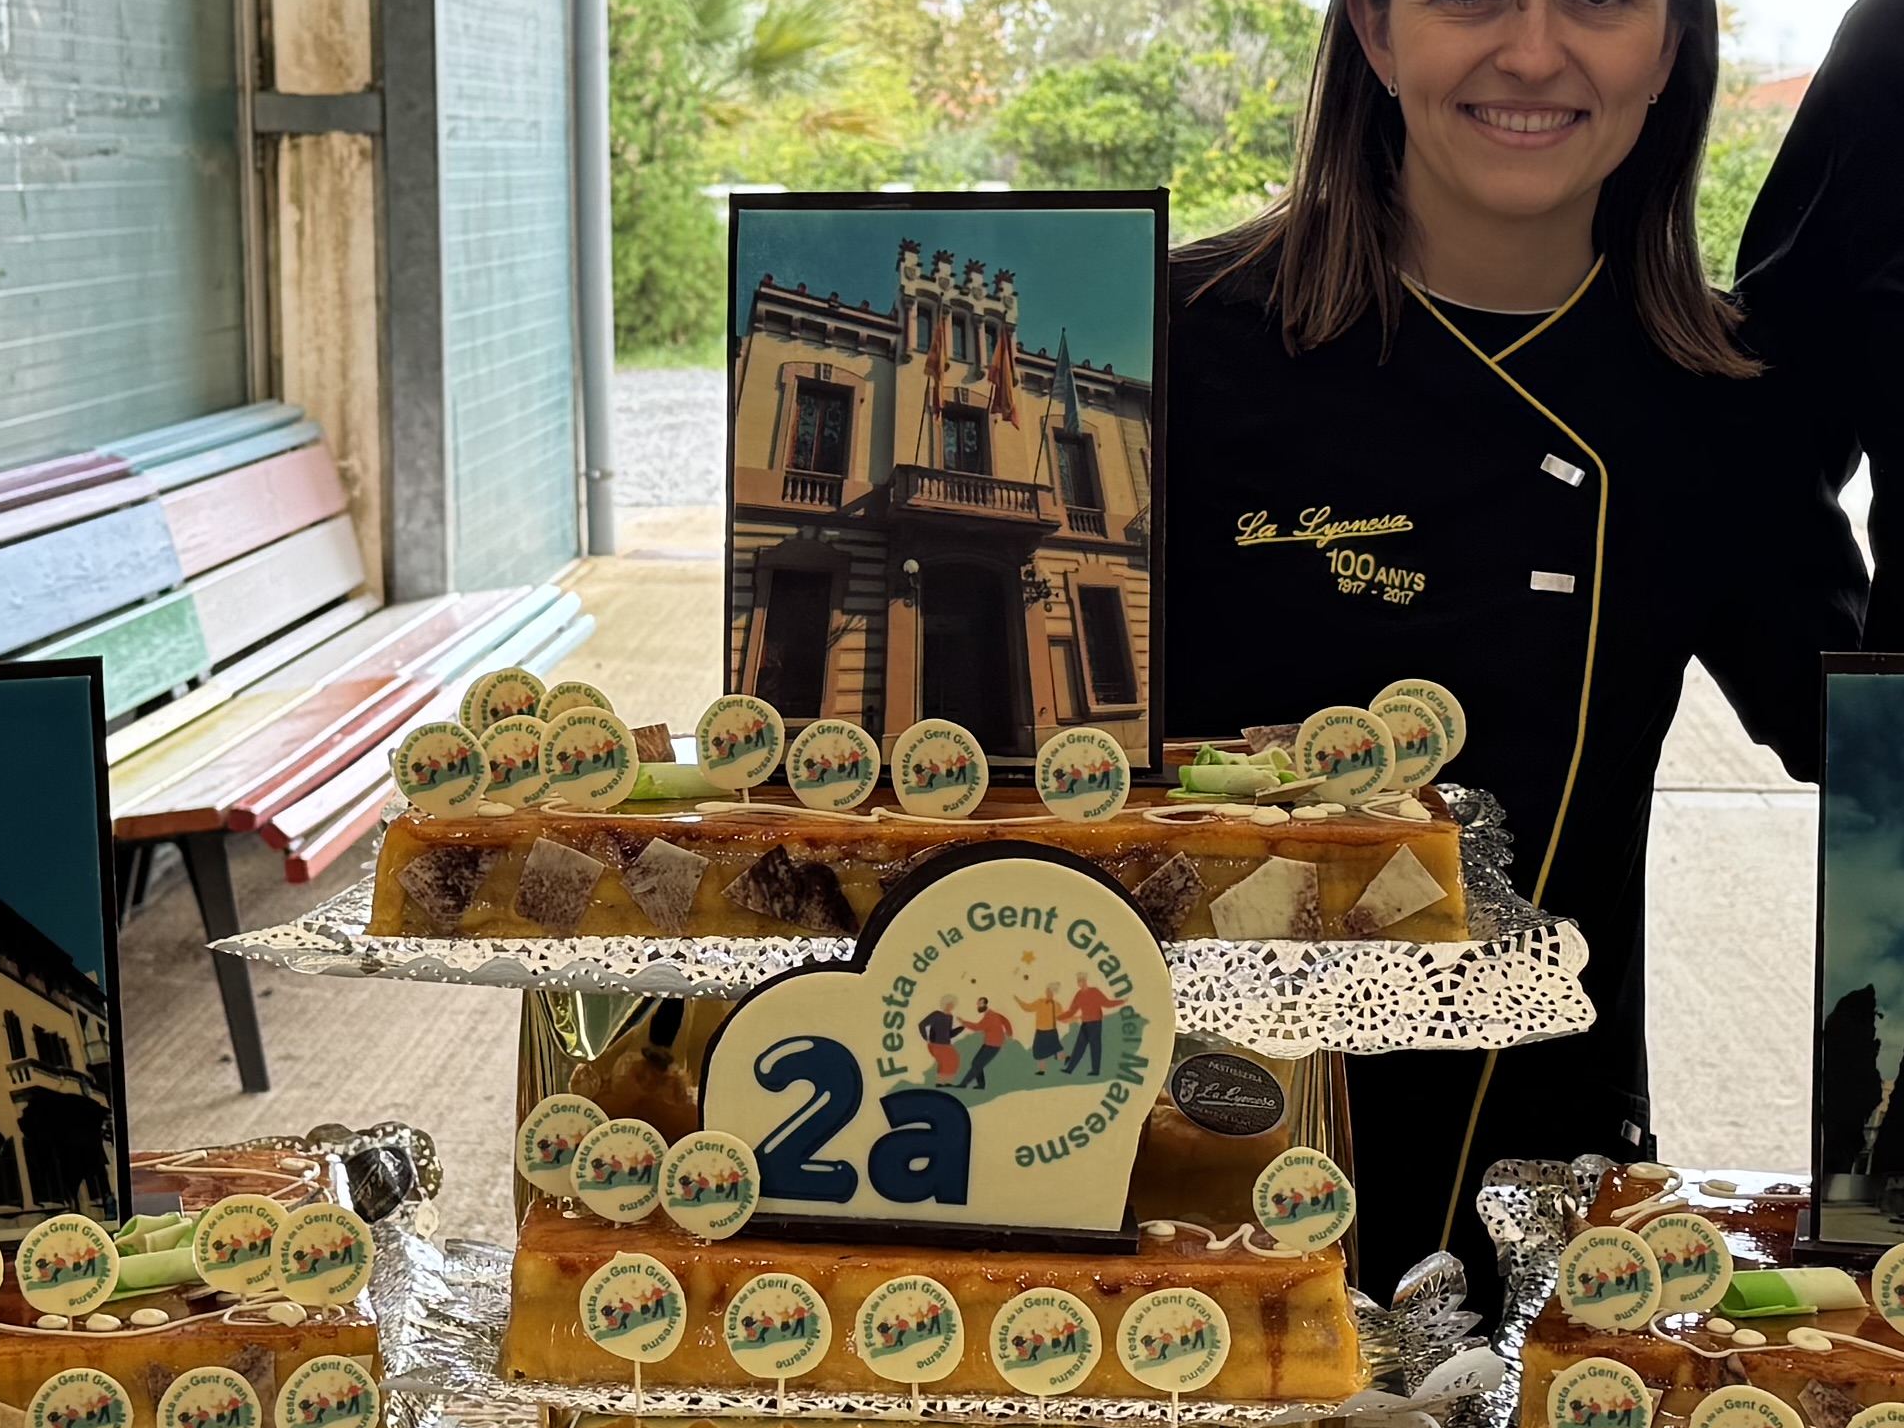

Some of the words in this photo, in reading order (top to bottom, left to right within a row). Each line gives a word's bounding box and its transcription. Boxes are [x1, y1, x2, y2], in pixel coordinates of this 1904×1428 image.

[1235, 510, 1278, 542] La
[1292, 505, 1414, 548] Lyonesa
[1326, 548, 1376, 581] 100
[1374, 566, 1426, 592] ANYS
[1336, 577, 1367, 595] 1917
[1382, 587, 1415, 605] 2017
[566, 715, 596, 727] Gent
[598, 718, 623, 743] Gran
[544, 740, 555, 775] Festa
[590, 759, 630, 799] Maresme
[966, 901, 1059, 933] Gent
[934, 925, 966, 952] la
[911, 944, 941, 982] de
[1066, 917, 1134, 999] Gran
[877, 978, 919, 1078] Festa
[1118, 1003, 1141, 1041] del
[753, 1034, 973, 1206] 2a
[1013, 1052, 1150, 1170] Maresme
[609, 1263, 641, 1278] Gent
[644, 1264, 672, 1290] Gran
[756, 1278, 789, 1291] Gent
[886, 1280, 918, 1295] Gent
[791, 1282, 816, 1310] Gran
[920, 1281, 948, 1307] Gran
[1023, 1296, 1055, 1309] Gent
[1058, 1299, 1084, 1325] Gran
[1150, 1294, 1183, 1308] Gent
[1185, 1296, 1212, 1322] Gran
[586, 1294, 601, 1332] Festa
[641, 1306, 681, 1353] Maresme
[727, 1303, 741, 1340] Festa
[863, 1312, 877, 1349] Festa
[775, 1329, 821, 1370] Maresme
[916, 1323, 957, 1369] Maresme
[998, 1324, 1011, 1361] Festa
[1127, 1324, 1140, 1361] Festa
[1179, 1338, 1221, 1384] Maresme
[1049, 1343, 1092, 1386] Maresme
